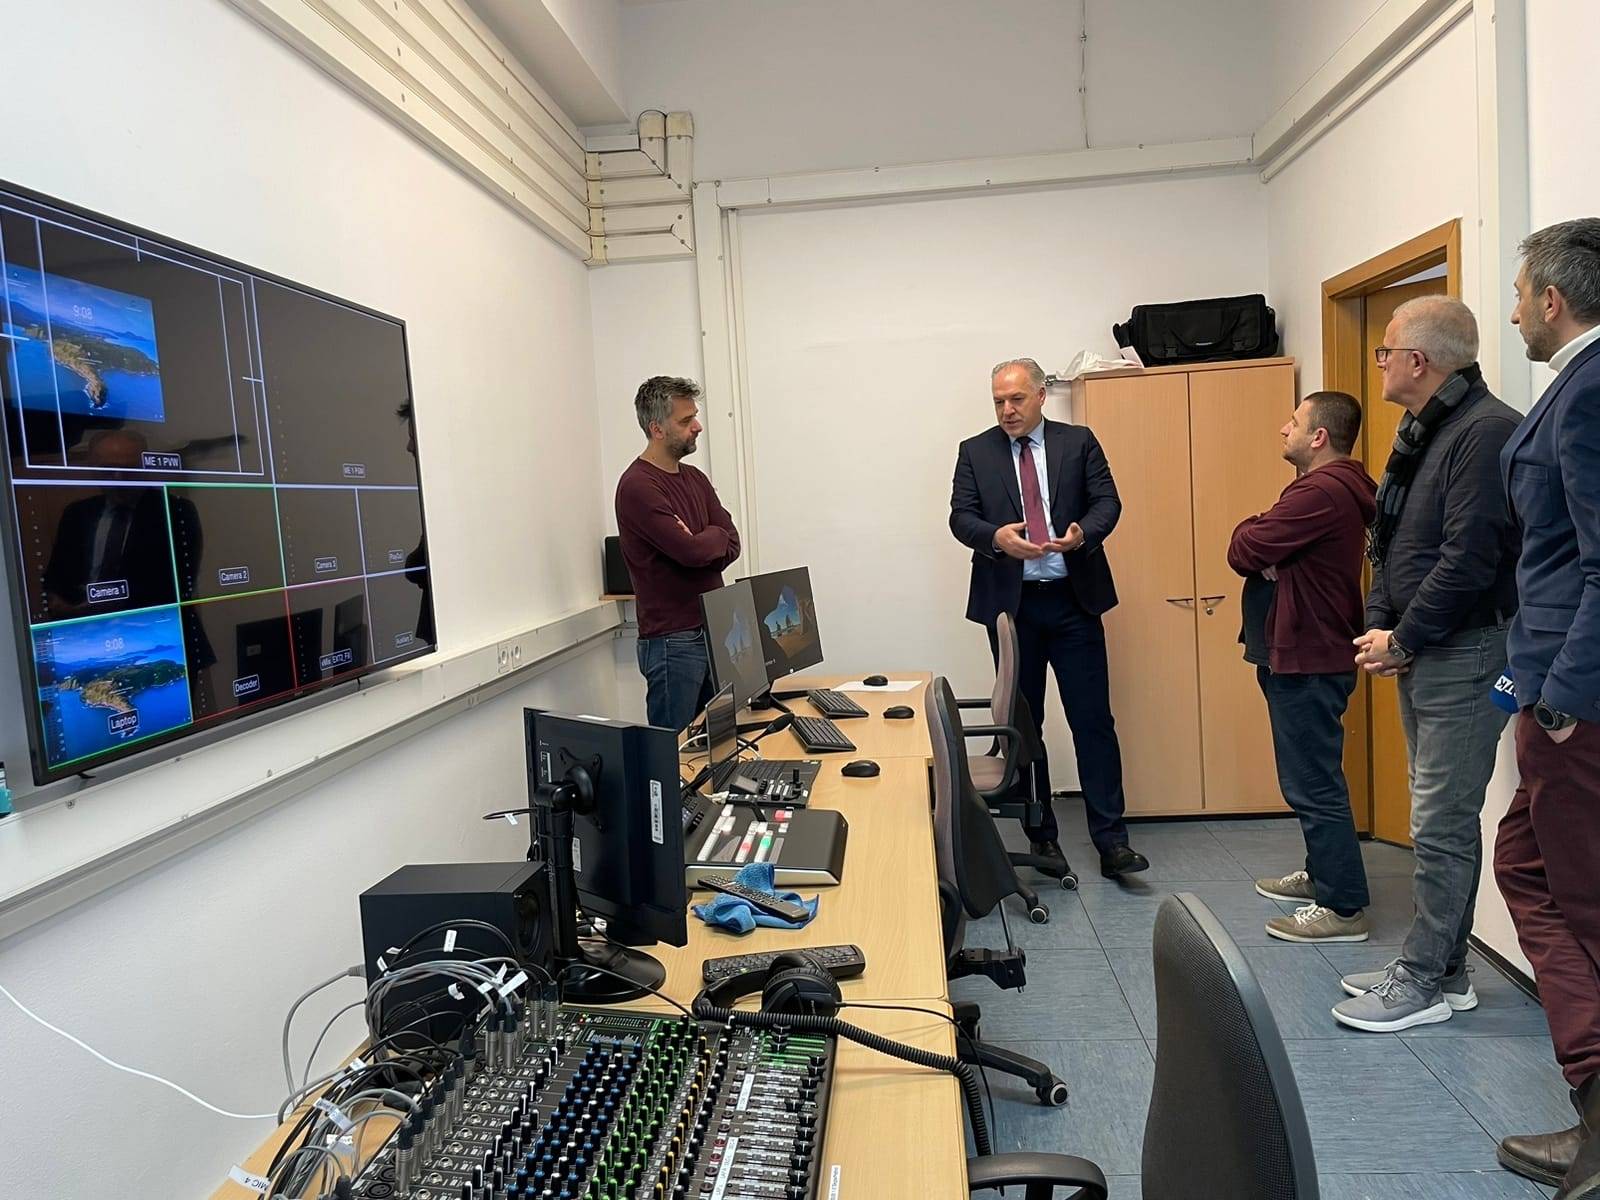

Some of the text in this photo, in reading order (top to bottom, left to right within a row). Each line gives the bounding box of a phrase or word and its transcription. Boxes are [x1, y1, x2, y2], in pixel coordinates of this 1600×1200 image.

[144, 456, 156, 466] ME
[222, 573, 243, 581] Camera
[90, 585, 126, 598] Camera 1
[105, 638, 124, 650] 9:08
[235, 681, 258, 692] Decoder
[1494, 674, 1517, 697] TK
[112, 715, 137, 729] Laptop
